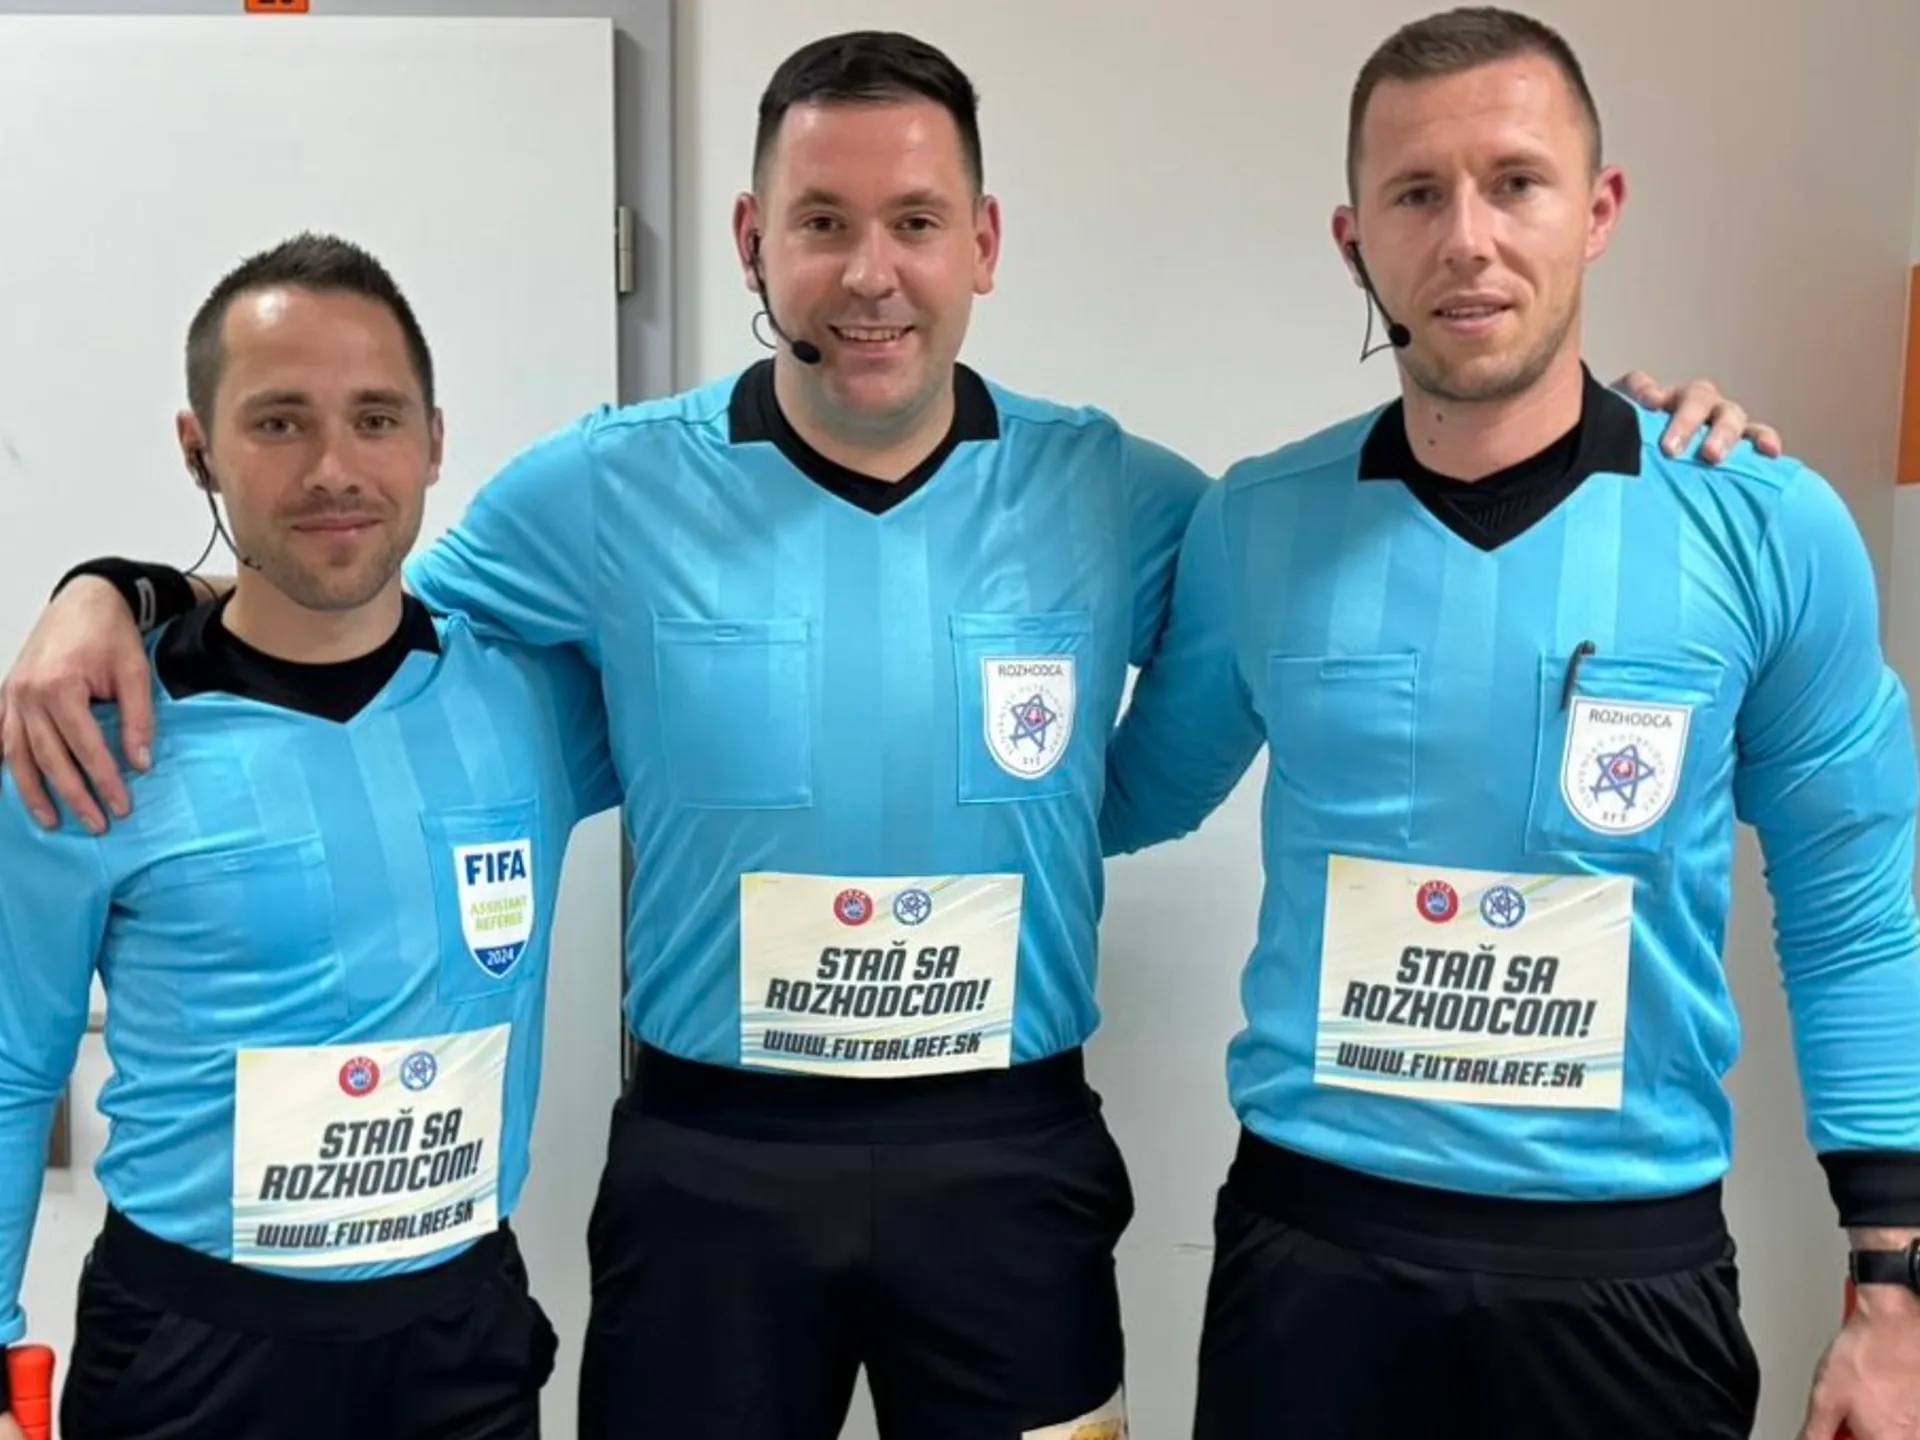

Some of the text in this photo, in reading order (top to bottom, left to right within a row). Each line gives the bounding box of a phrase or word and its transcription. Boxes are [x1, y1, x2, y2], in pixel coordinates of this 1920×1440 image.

[998, 663, 1063, 677] ROZHODCA
[1588, 708, 1672, 728] ROZHODCA
[464, 848, 527, 886] FIFA
[487, 947, 515, 966] 2024
[816, 940, 959, 982] STAŇ SA
[1396, 943, 1557, 995] STAŇ SA
[765, 978, 990, 1018] ROZHODCOM!
[1341, 980, 1595, 1038] ROZHODCOM!
[763, 1028, 981, 1062] WWW.FUTBALREF.SK
[1336, 1041, 1585, 1088] WWW.FUTBALREF.SK
[319, 1107, 461, 1159] STAŇ SA
[258, 1138, 482, 1201] ROZHODCOM!
[256, 1198, 474, 1248] WWW.FUTBALREF.SK
